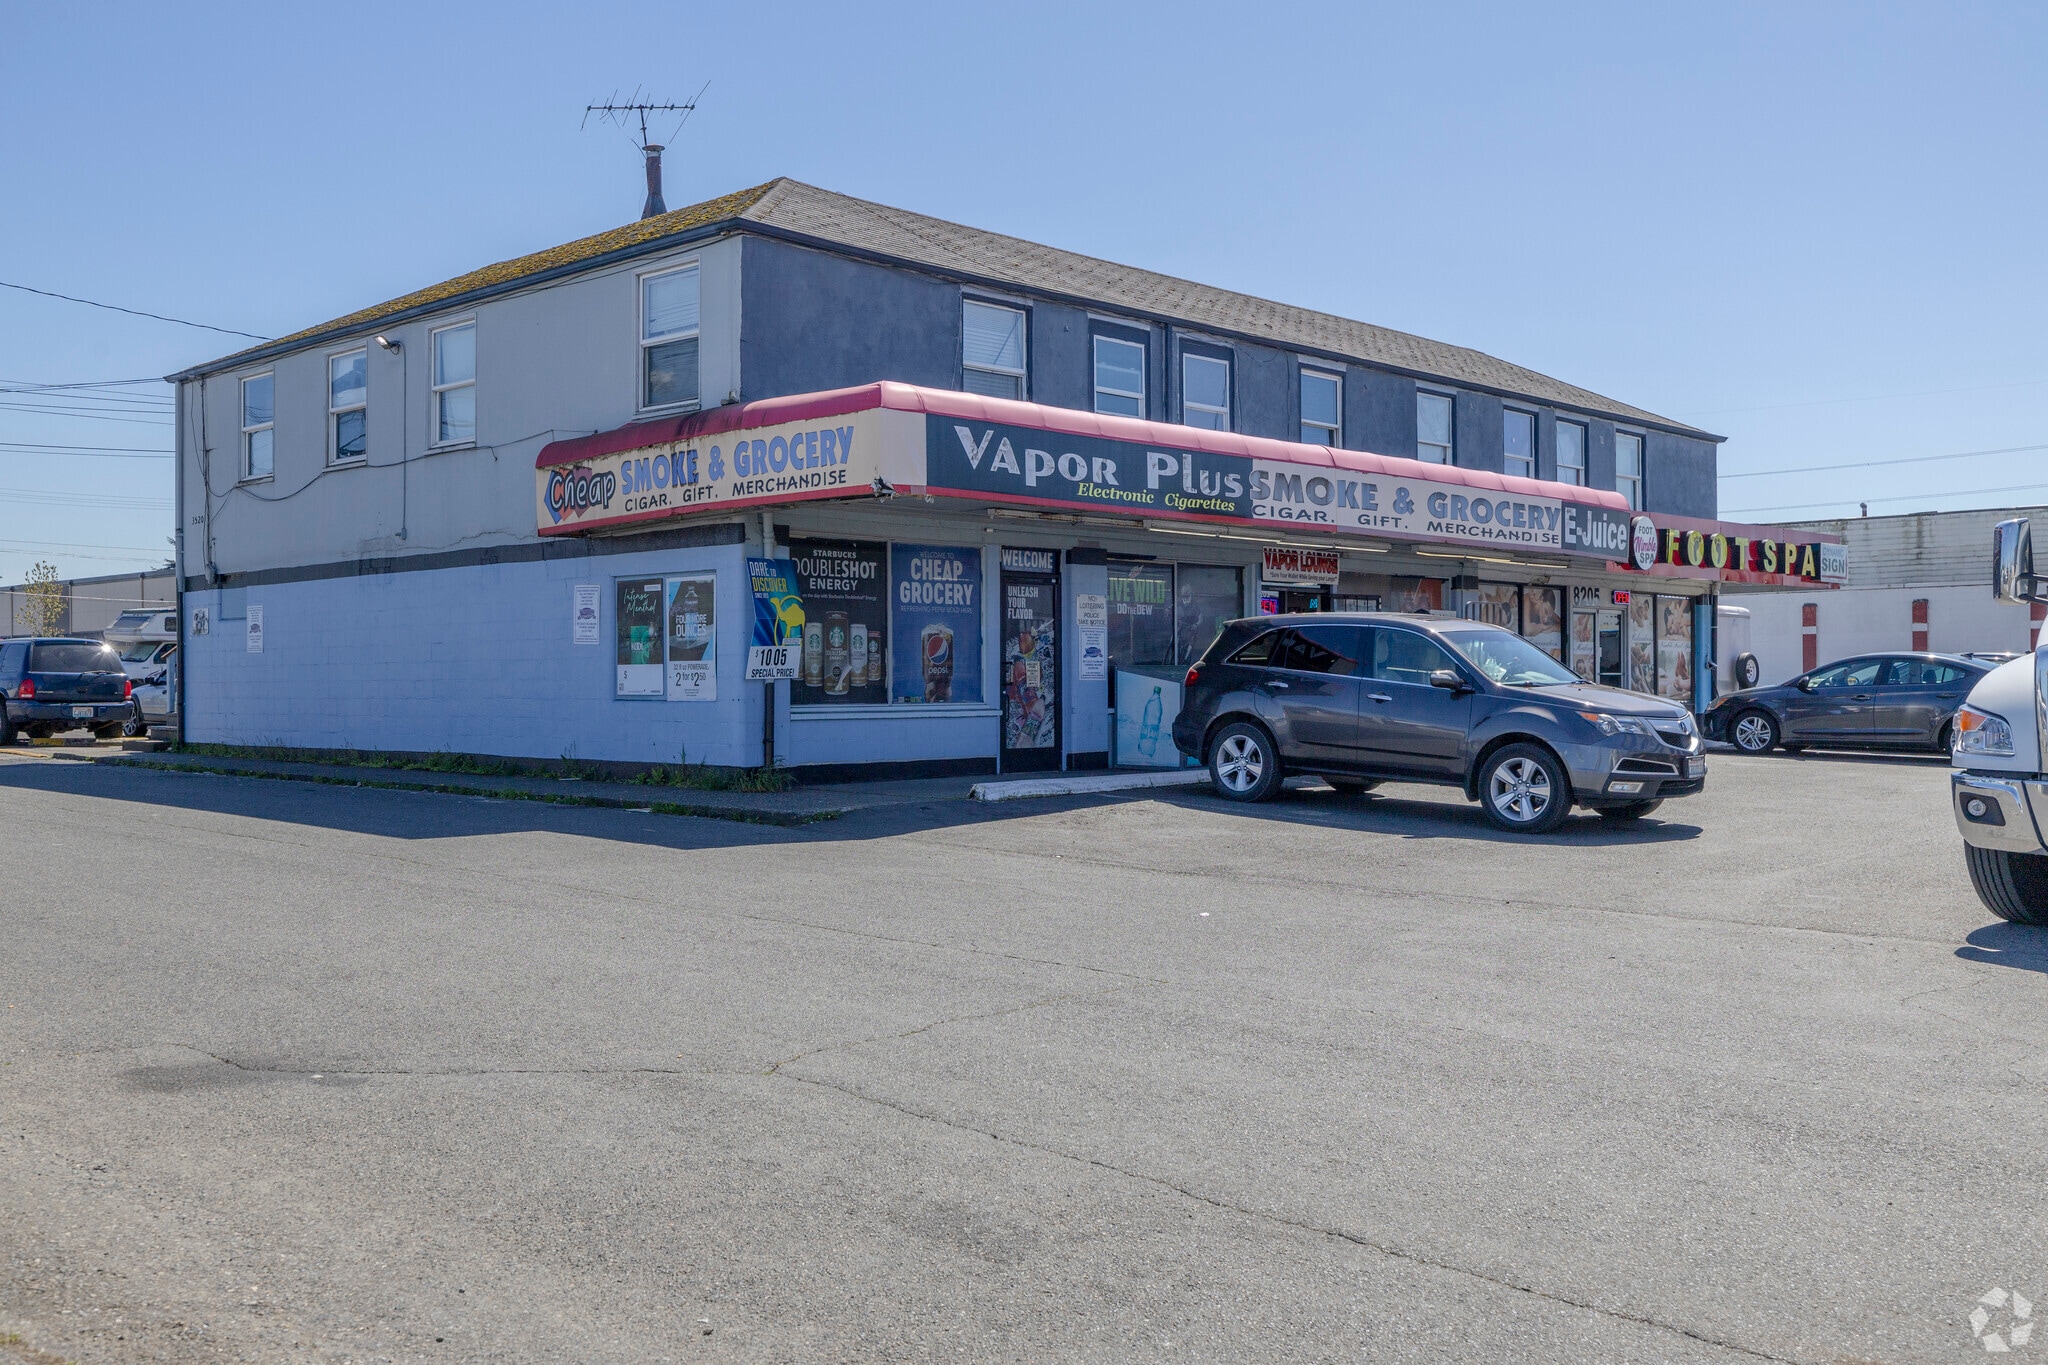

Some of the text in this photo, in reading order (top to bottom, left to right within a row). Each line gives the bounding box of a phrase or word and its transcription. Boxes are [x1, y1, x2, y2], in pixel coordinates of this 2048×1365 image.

[621, 425, 854, 495] SMOKE & GROCERY
[732, 469, 847, 496] MERCHANDISE
[549, 469, 616, 513] Cheap
[1078, 482, 1235, 512] Electronic Cigarettes
[1250, 469, 1562, 531] SMOKE & GROCERY
[1427, 521, 1560, 544] MERCHANDISE
[1565, 507, 1627, 551] E-Juice
[1639, 526, 1653, 535] FOOT
[1634, 536, 1656, 553] Nimble
[1666, 528, 1816, 577] FOOT SPA
[813, 549, 857, 559] STARBUCKS
[919, 551, 945, 559] WELCOME
[1002, 549, 1053, 569] WELCOME
[1263, 547, 1338, 574] VAPOR LOUNGE
[1640, 552, 1655, 564] SPA
[749, 561, 777, 576] DARE TO
[910, 558, 963, 581] CHEAP
[1822, 557, 1845, 574] SIGN
[752, 577, 788, 592] DISCOVER
[809, 578, 858, 591] ENERGY
[1007, 585, 1039, 598] UNLEASH
[1107, 579, 1165, 604] IVE WILD
[623, 588, 650, 605] Intense
[899, 581, 974, 606] GROCERY
[1573, 586, 1600, 606] 8205
[1615, 591, 1629, 604] OPEN
[626, 599, 657, 616] Menthol
[900, 605, 931, 613] REFRESHING
[1007, 597, 1026, 608] YOUR
[1079, 602, 1105, 610] LOITERING
[1136, 604, 1153, 616] DEW
[1261, 599, 1277, 615] PEN
[1007, 608, 1033, 620] FLAVOR
[676, 624, 707, 637] OUNCES
[755, 648, 788, 666] $10.05
[751, 668, 795, 678] SPECIAL PRICE!
[928, 666, 948, 675] pepsi
[675, 672, 682, 686] 2
[682, 672, 690, 681] for
